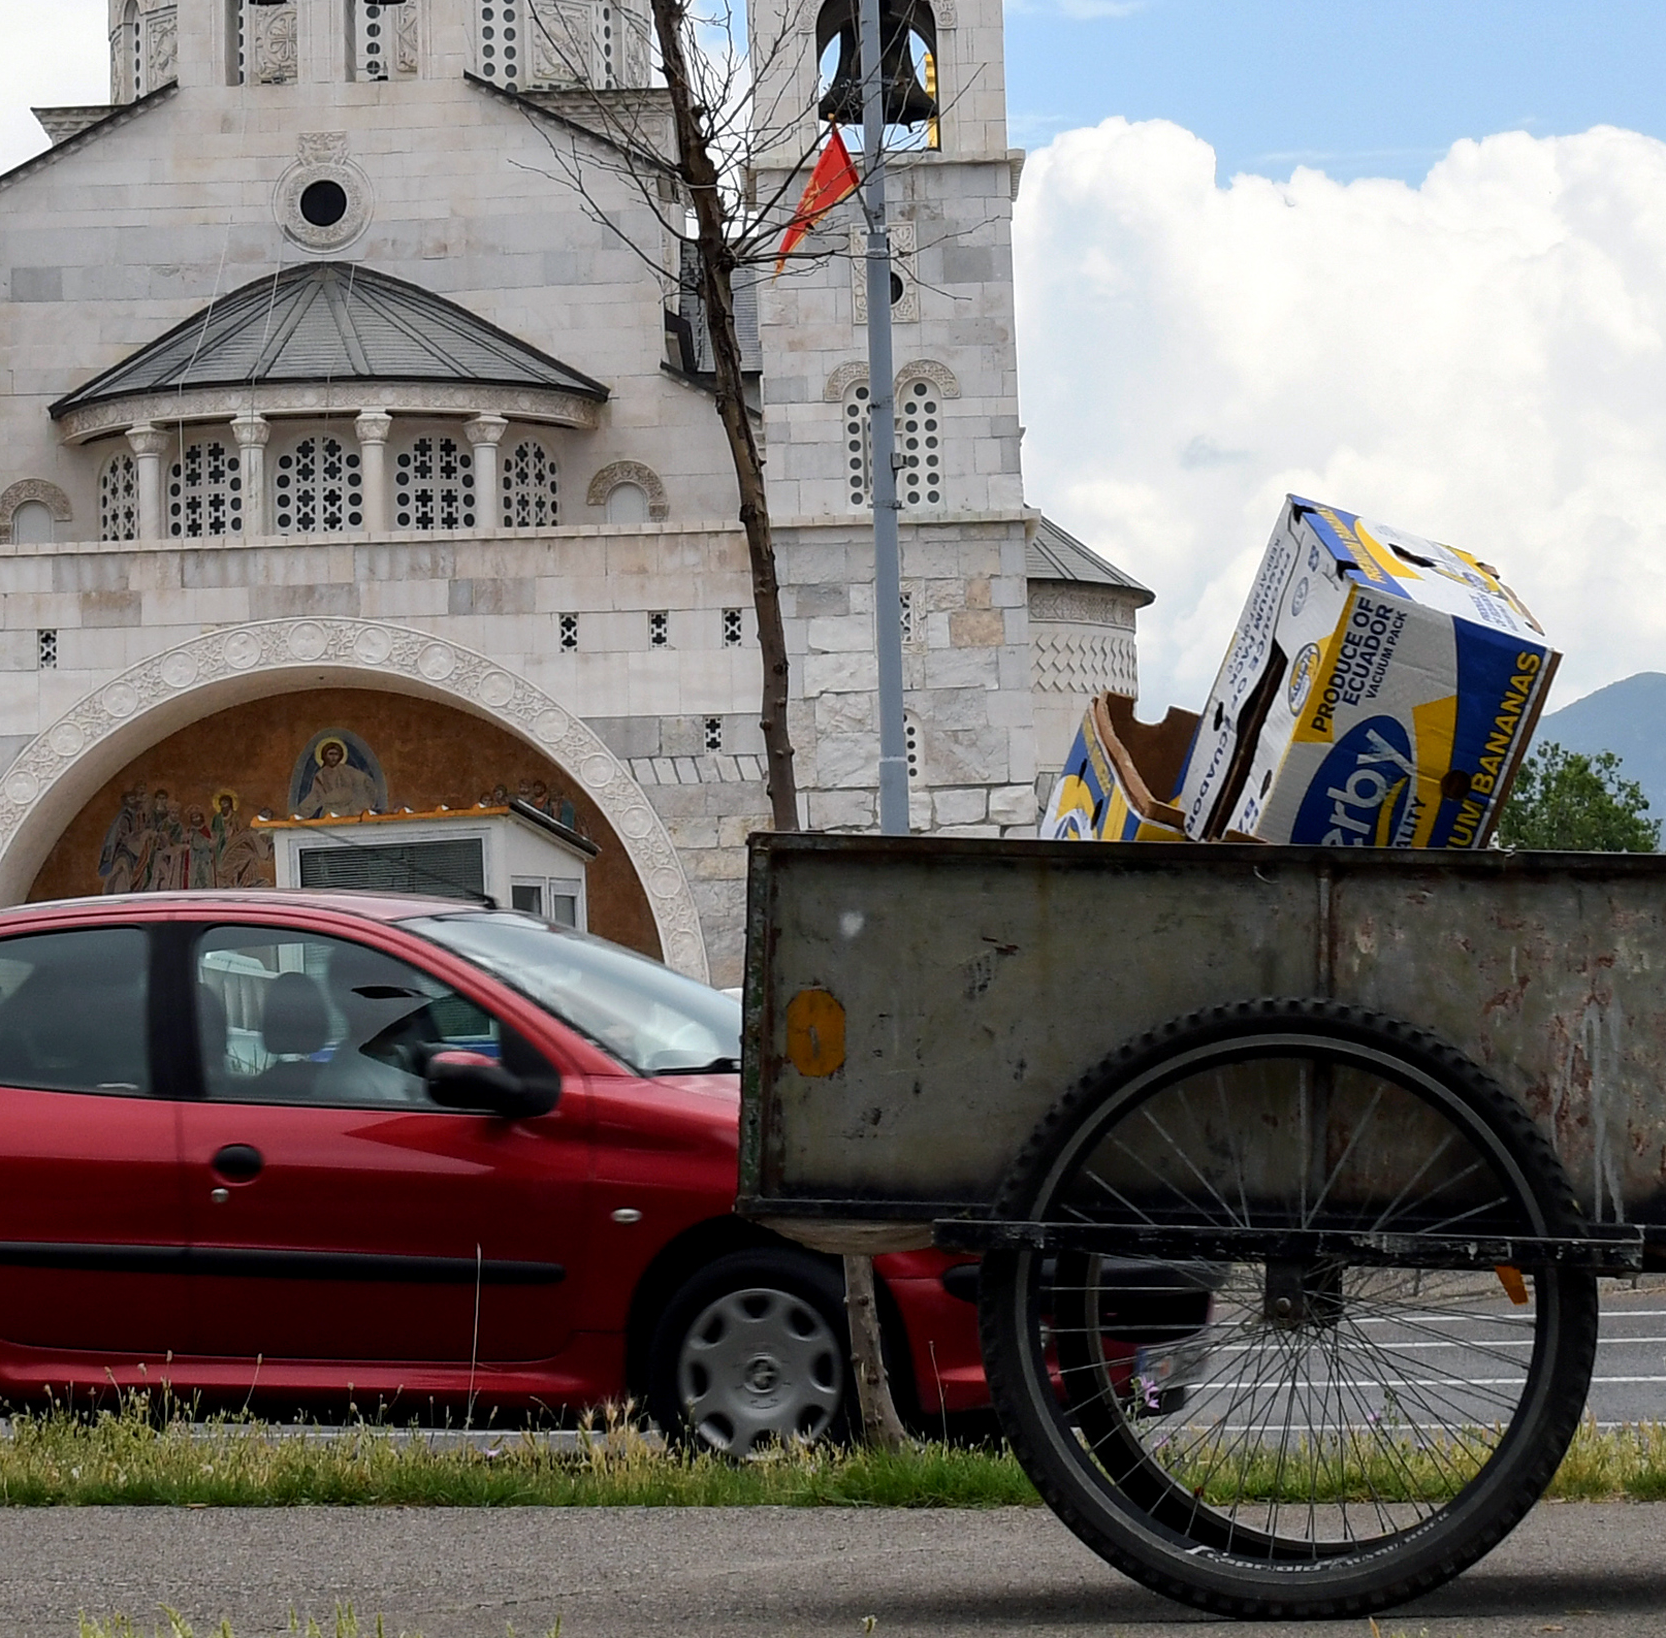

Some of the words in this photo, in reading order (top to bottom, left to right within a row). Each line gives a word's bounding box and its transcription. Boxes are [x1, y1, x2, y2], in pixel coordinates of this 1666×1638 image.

[1311, 631, 1363, 733] PRODUCE
[1352, 597, 1376, 629] OF
[1341, 604, 1394, 707] ECUADOR
[1365, 647, 1393, 699] VACUUM
[1387, 610, 1408, 647] PACK
[1470, 650, 1541, 796] BANANAS
